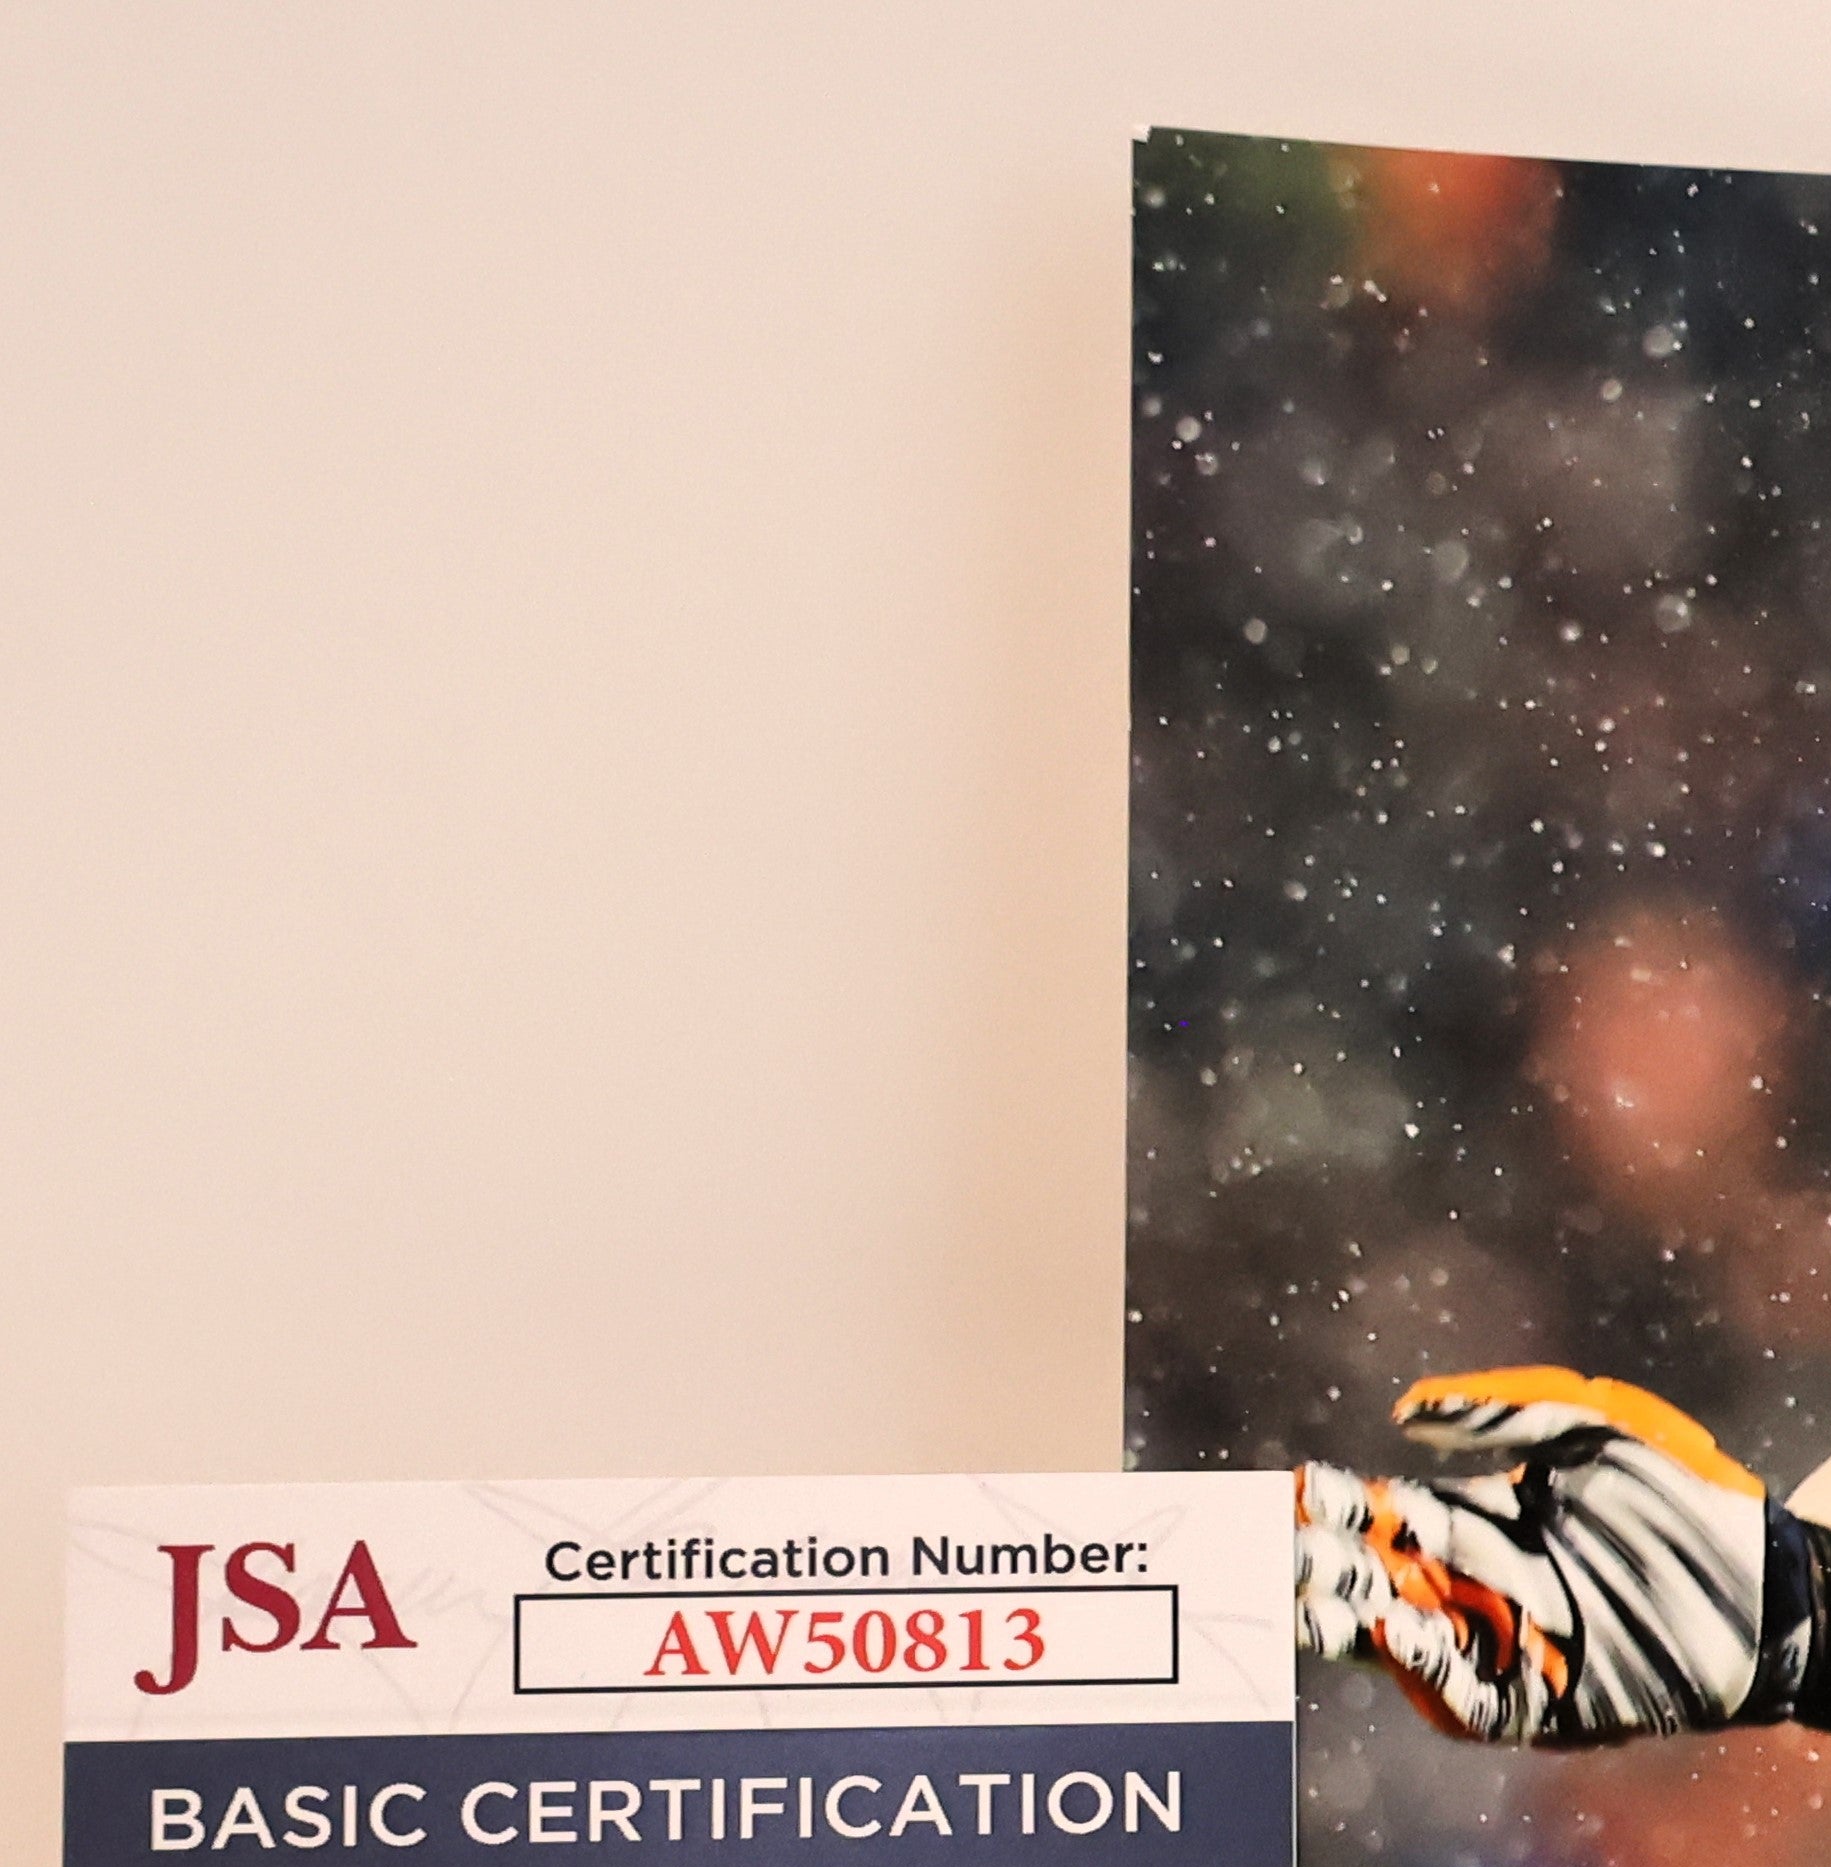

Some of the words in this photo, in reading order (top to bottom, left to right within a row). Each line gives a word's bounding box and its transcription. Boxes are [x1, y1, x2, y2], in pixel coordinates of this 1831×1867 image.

[545, 1536, 889, 1582] Certification
[913, 1534, 1147, 1576] Number:
[133, 1539, 418, 1696] JSA
[643, 1607, 1049, 1676] AW50813
[151, 1782, 427, 1851] BASIC
[461, 1770, 1180, 1845] CERTIFICATION
